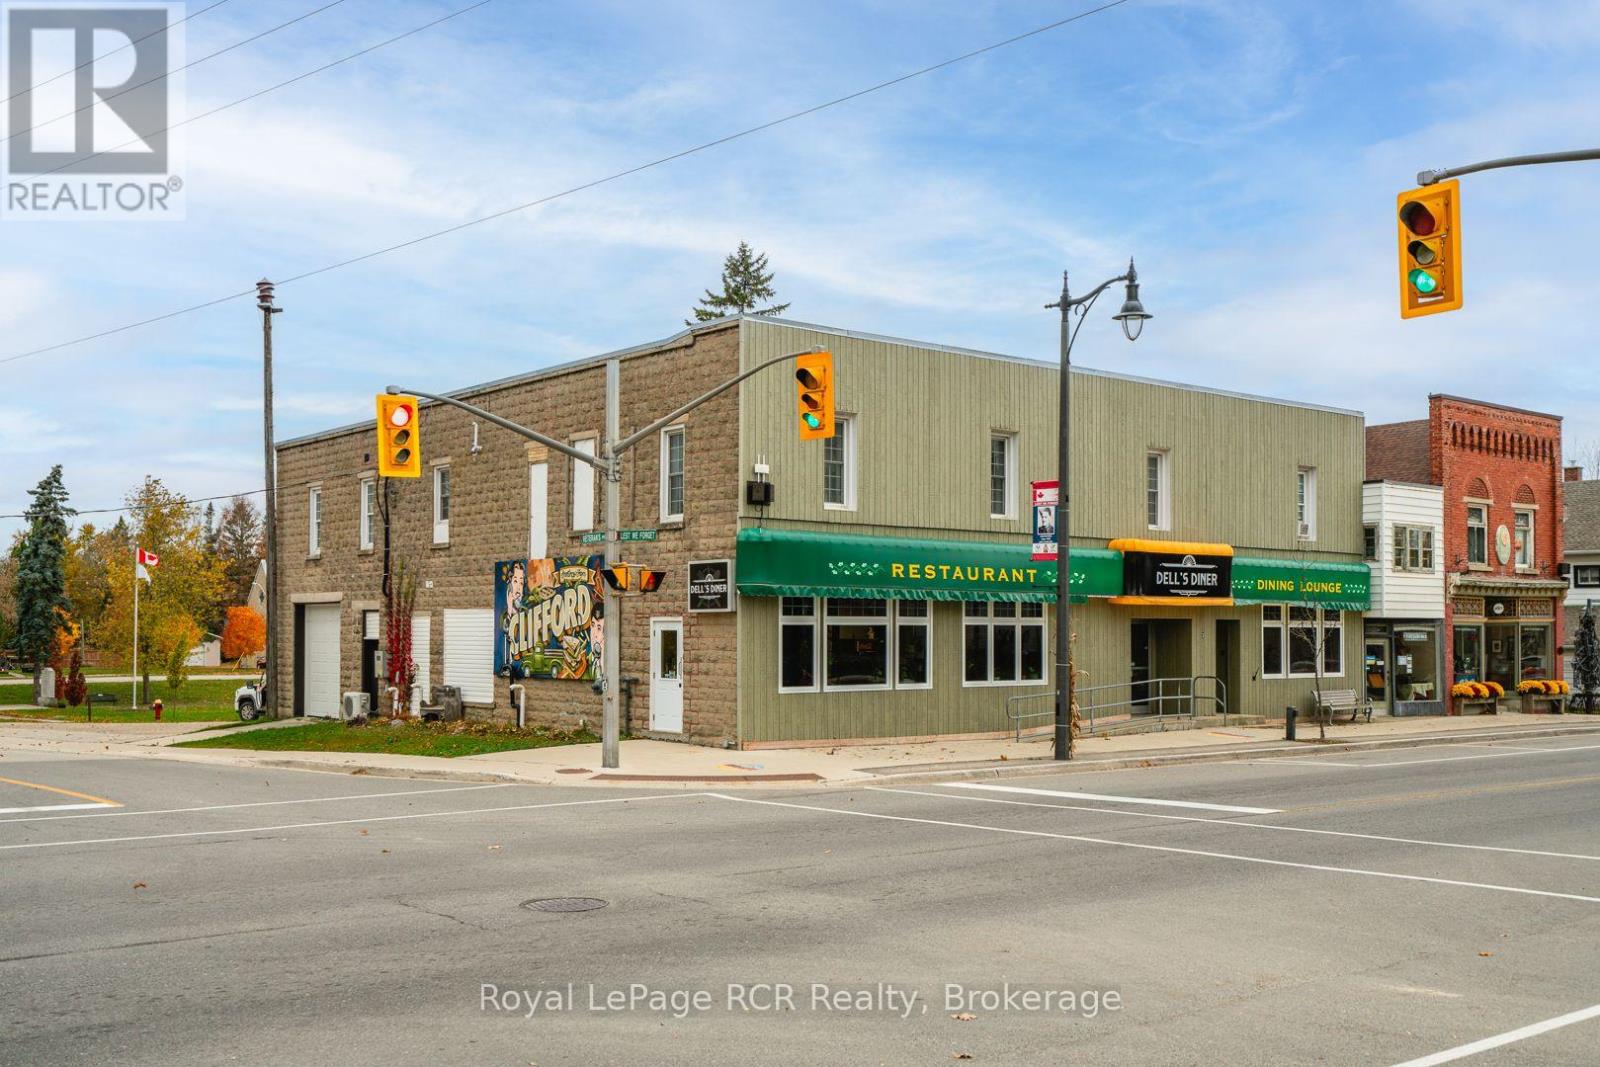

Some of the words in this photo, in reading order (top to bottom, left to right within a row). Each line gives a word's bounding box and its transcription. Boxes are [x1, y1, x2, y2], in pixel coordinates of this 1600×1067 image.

[620, 531, 631, 540] LEST
[632, 531, 639, 540] WE
[639, 530, 655, 540] FORGET
[891, 563, 1037, 582] RESTAURANT
[1156, 571, 1189, 586] DELL'S
[1190, 572, 1218, 586] DINER
[690, 584, 710, 594] DELL'S
[710, 584, 727, 593] DINER
[1257, 579, 1294, 592] DINING
[1300, 581, 1342, 593] LOUNGE
[508, 585, 592, 662] CLIFFORD
